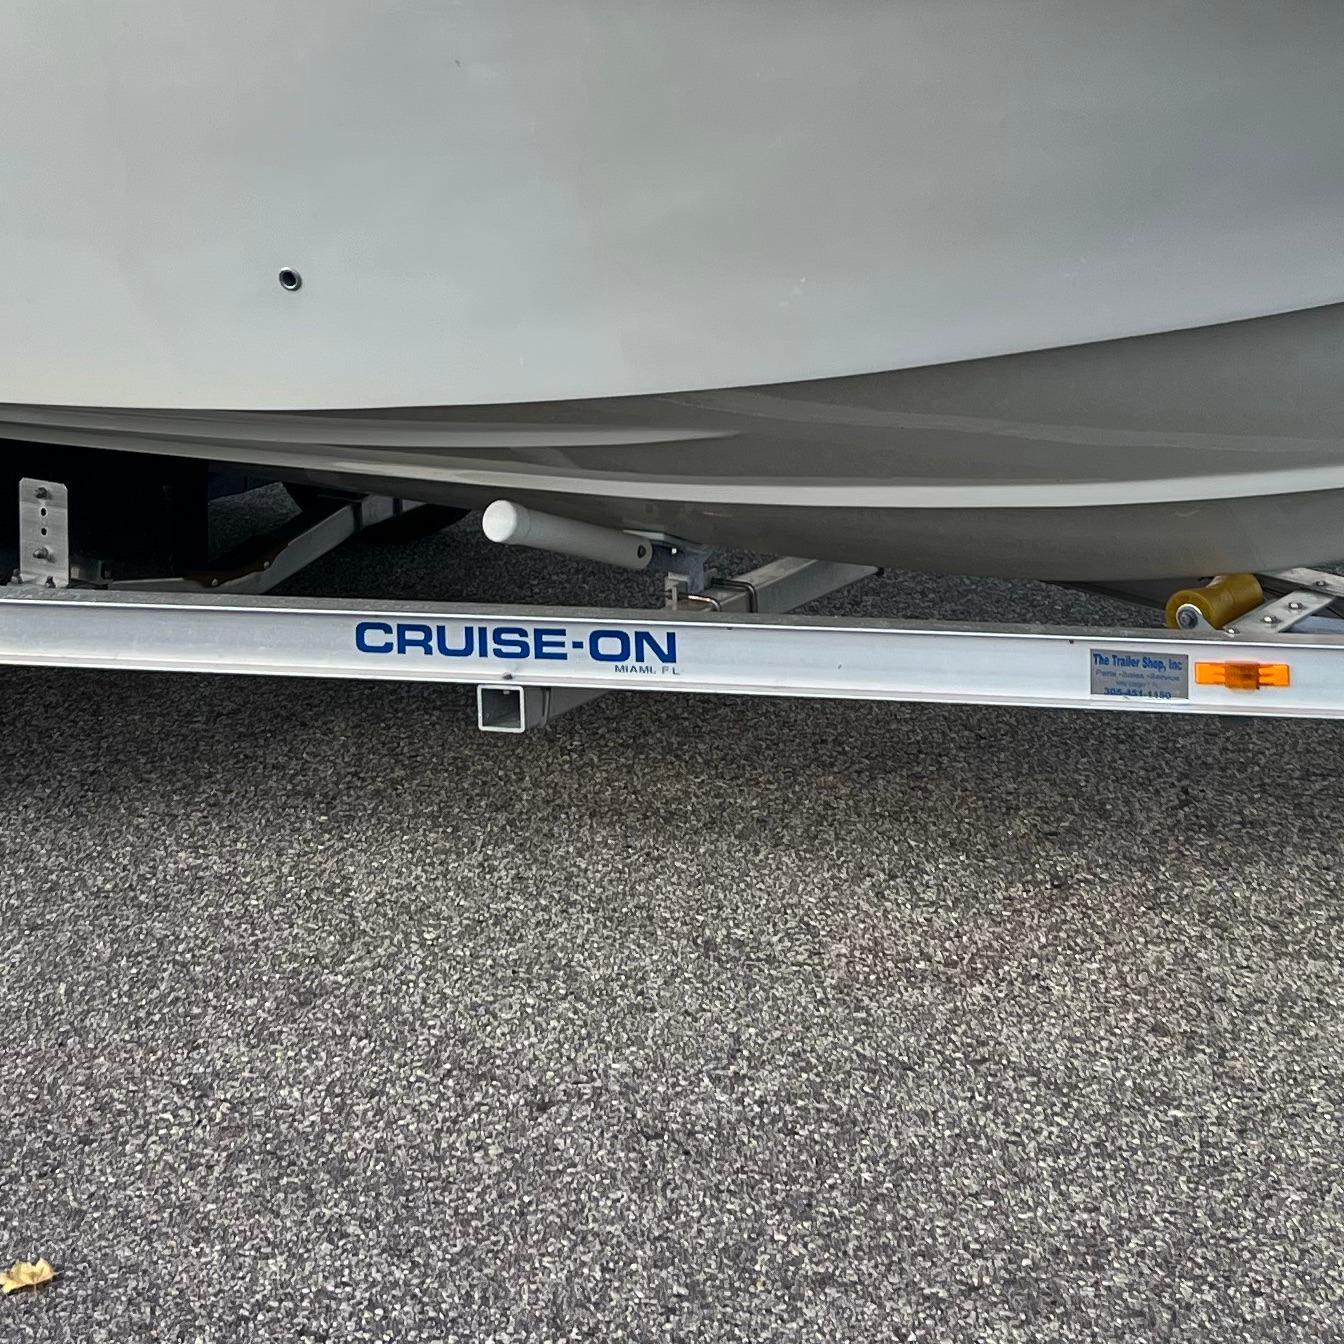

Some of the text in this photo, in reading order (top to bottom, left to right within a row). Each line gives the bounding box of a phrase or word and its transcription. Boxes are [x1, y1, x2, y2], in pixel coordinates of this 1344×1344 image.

[355, 621, 677, 664] CRUISE-ON
[1093, 653, 1183, 673] The Trailer Shop, Inc
